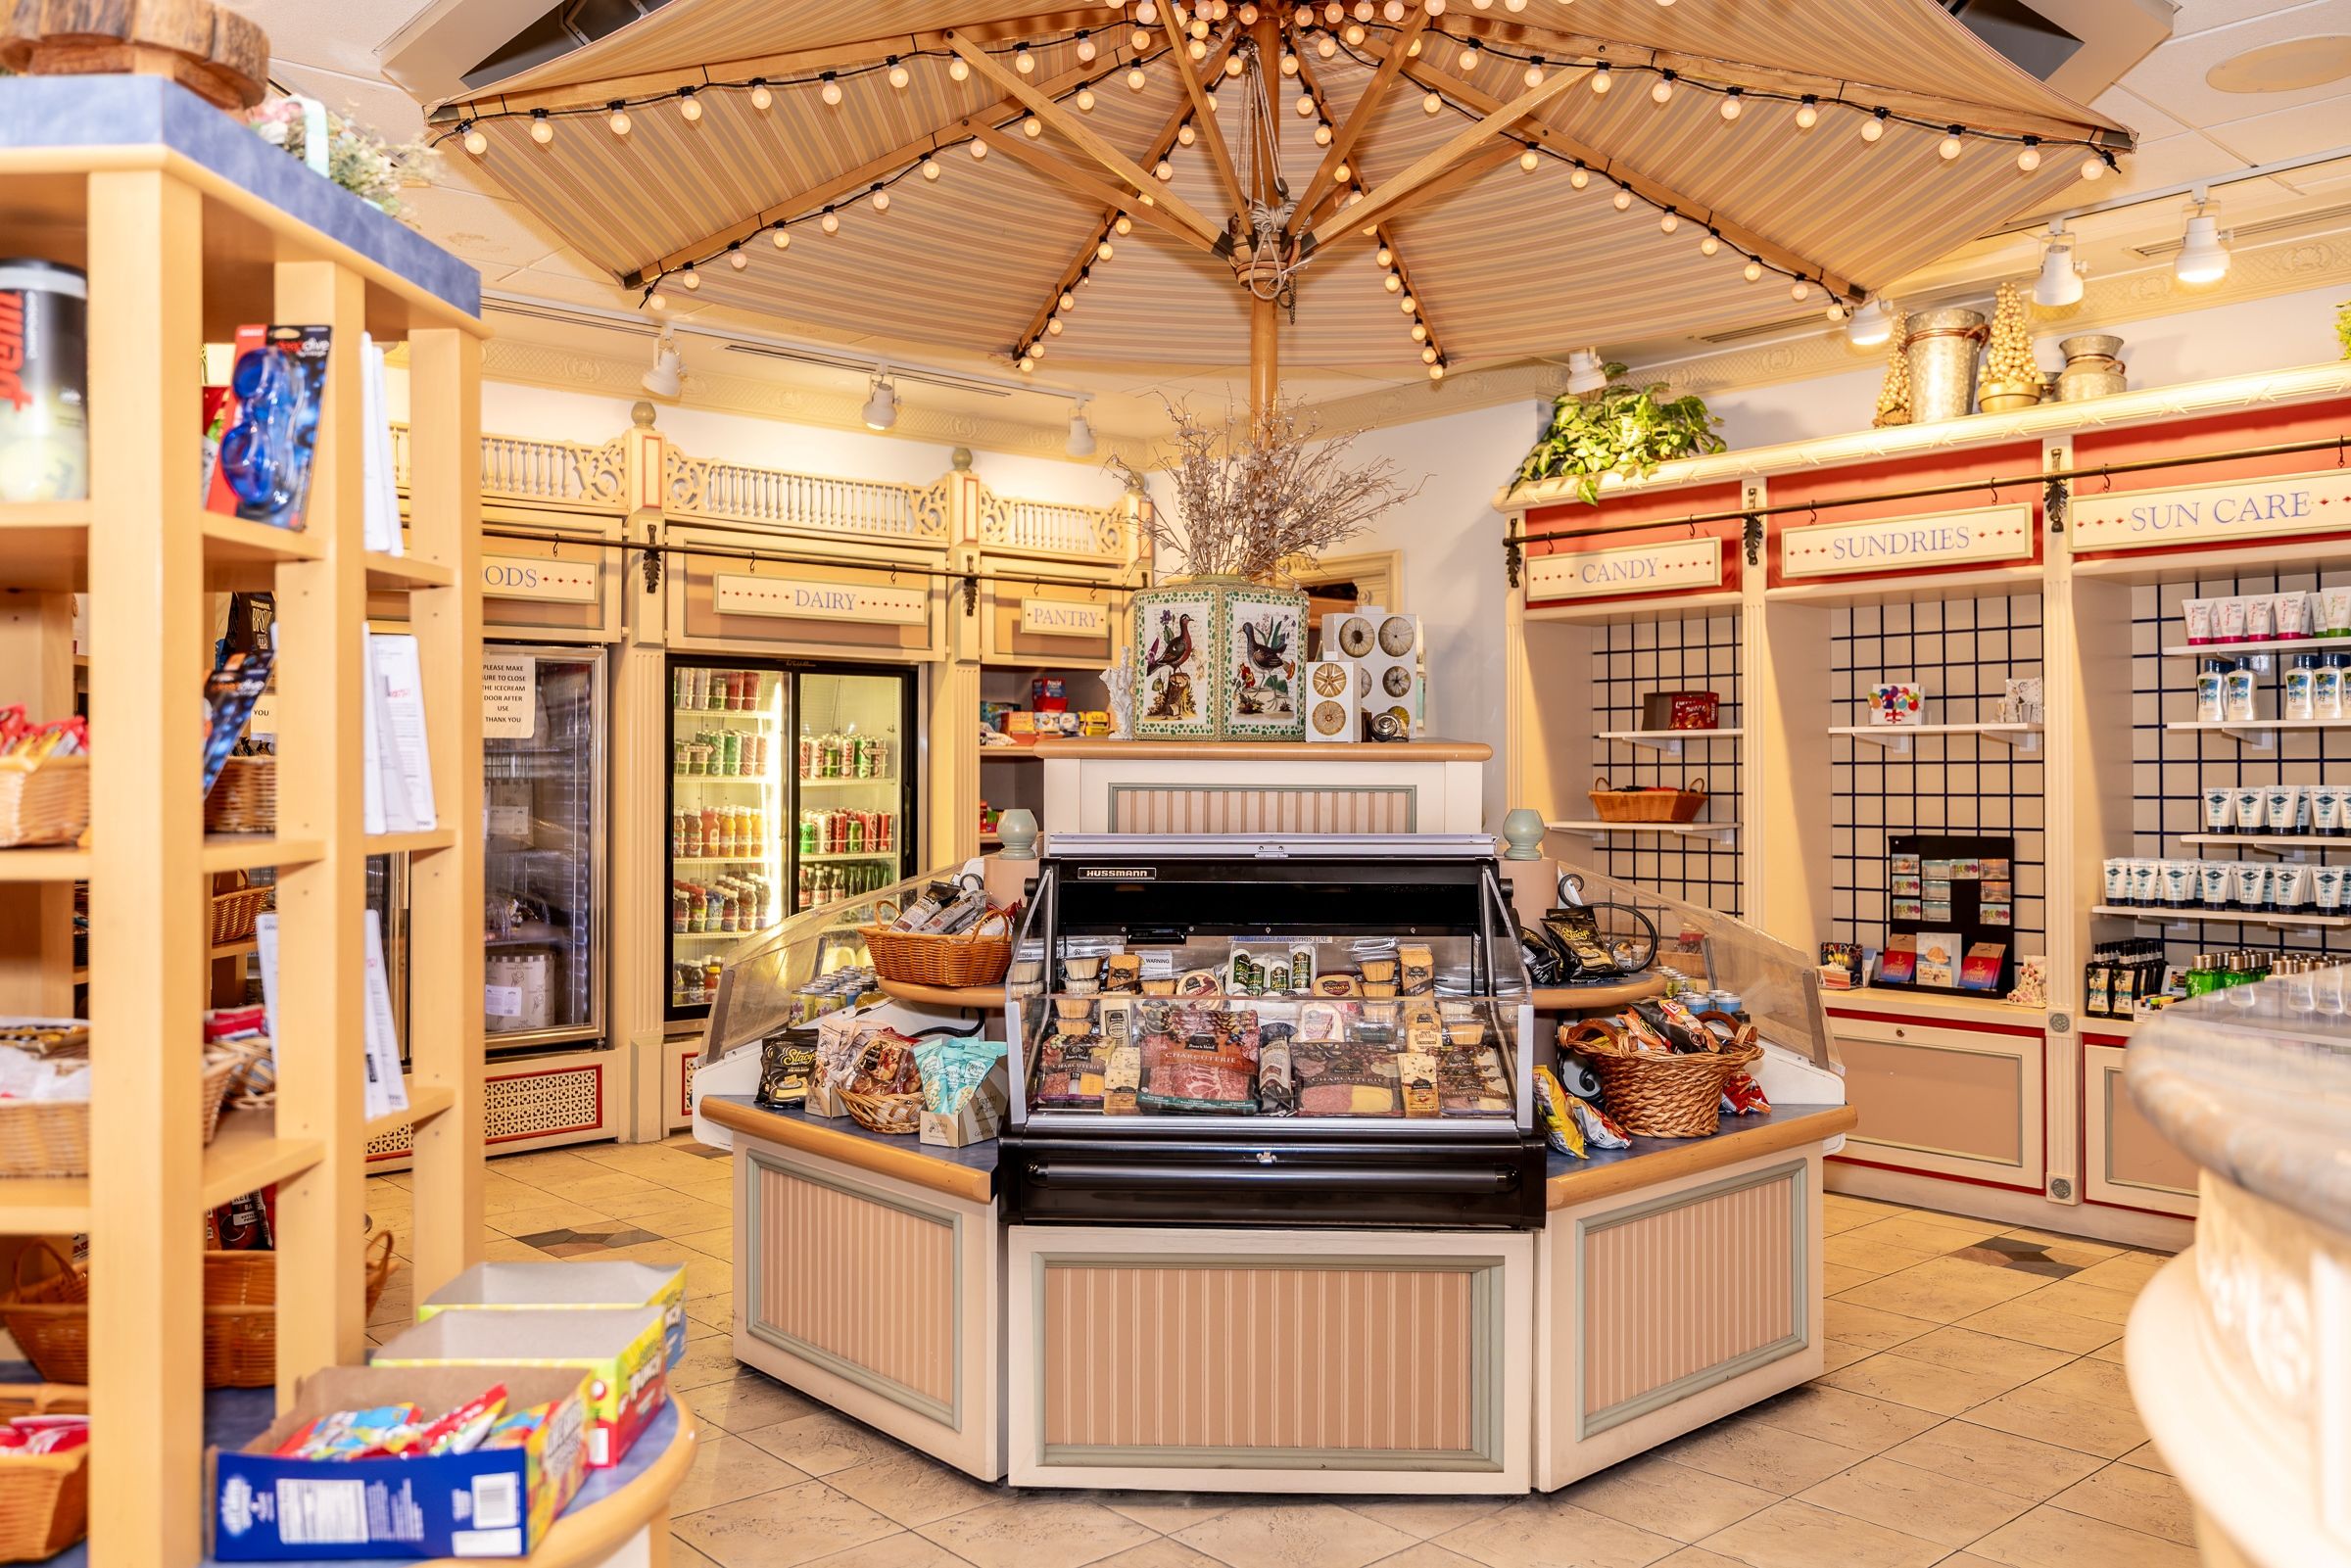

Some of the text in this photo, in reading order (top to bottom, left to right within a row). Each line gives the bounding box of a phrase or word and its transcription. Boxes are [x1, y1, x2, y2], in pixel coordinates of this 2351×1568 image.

[2132, 491, 2312, 531] SUN CARE
[1833, 526, 1970, 560] SUNDRIES
[481, 565, 537, 588] ODS
[1582, 557, 1658, 583] CANDY
[794, 590, 856, 610] DAIRY
[1034, 607, 1098, 627] PANTRY
[1822, 944, 1851, 954] HAPPY
[1165, 1052, 1236, 1064] CHARCUTERIE
